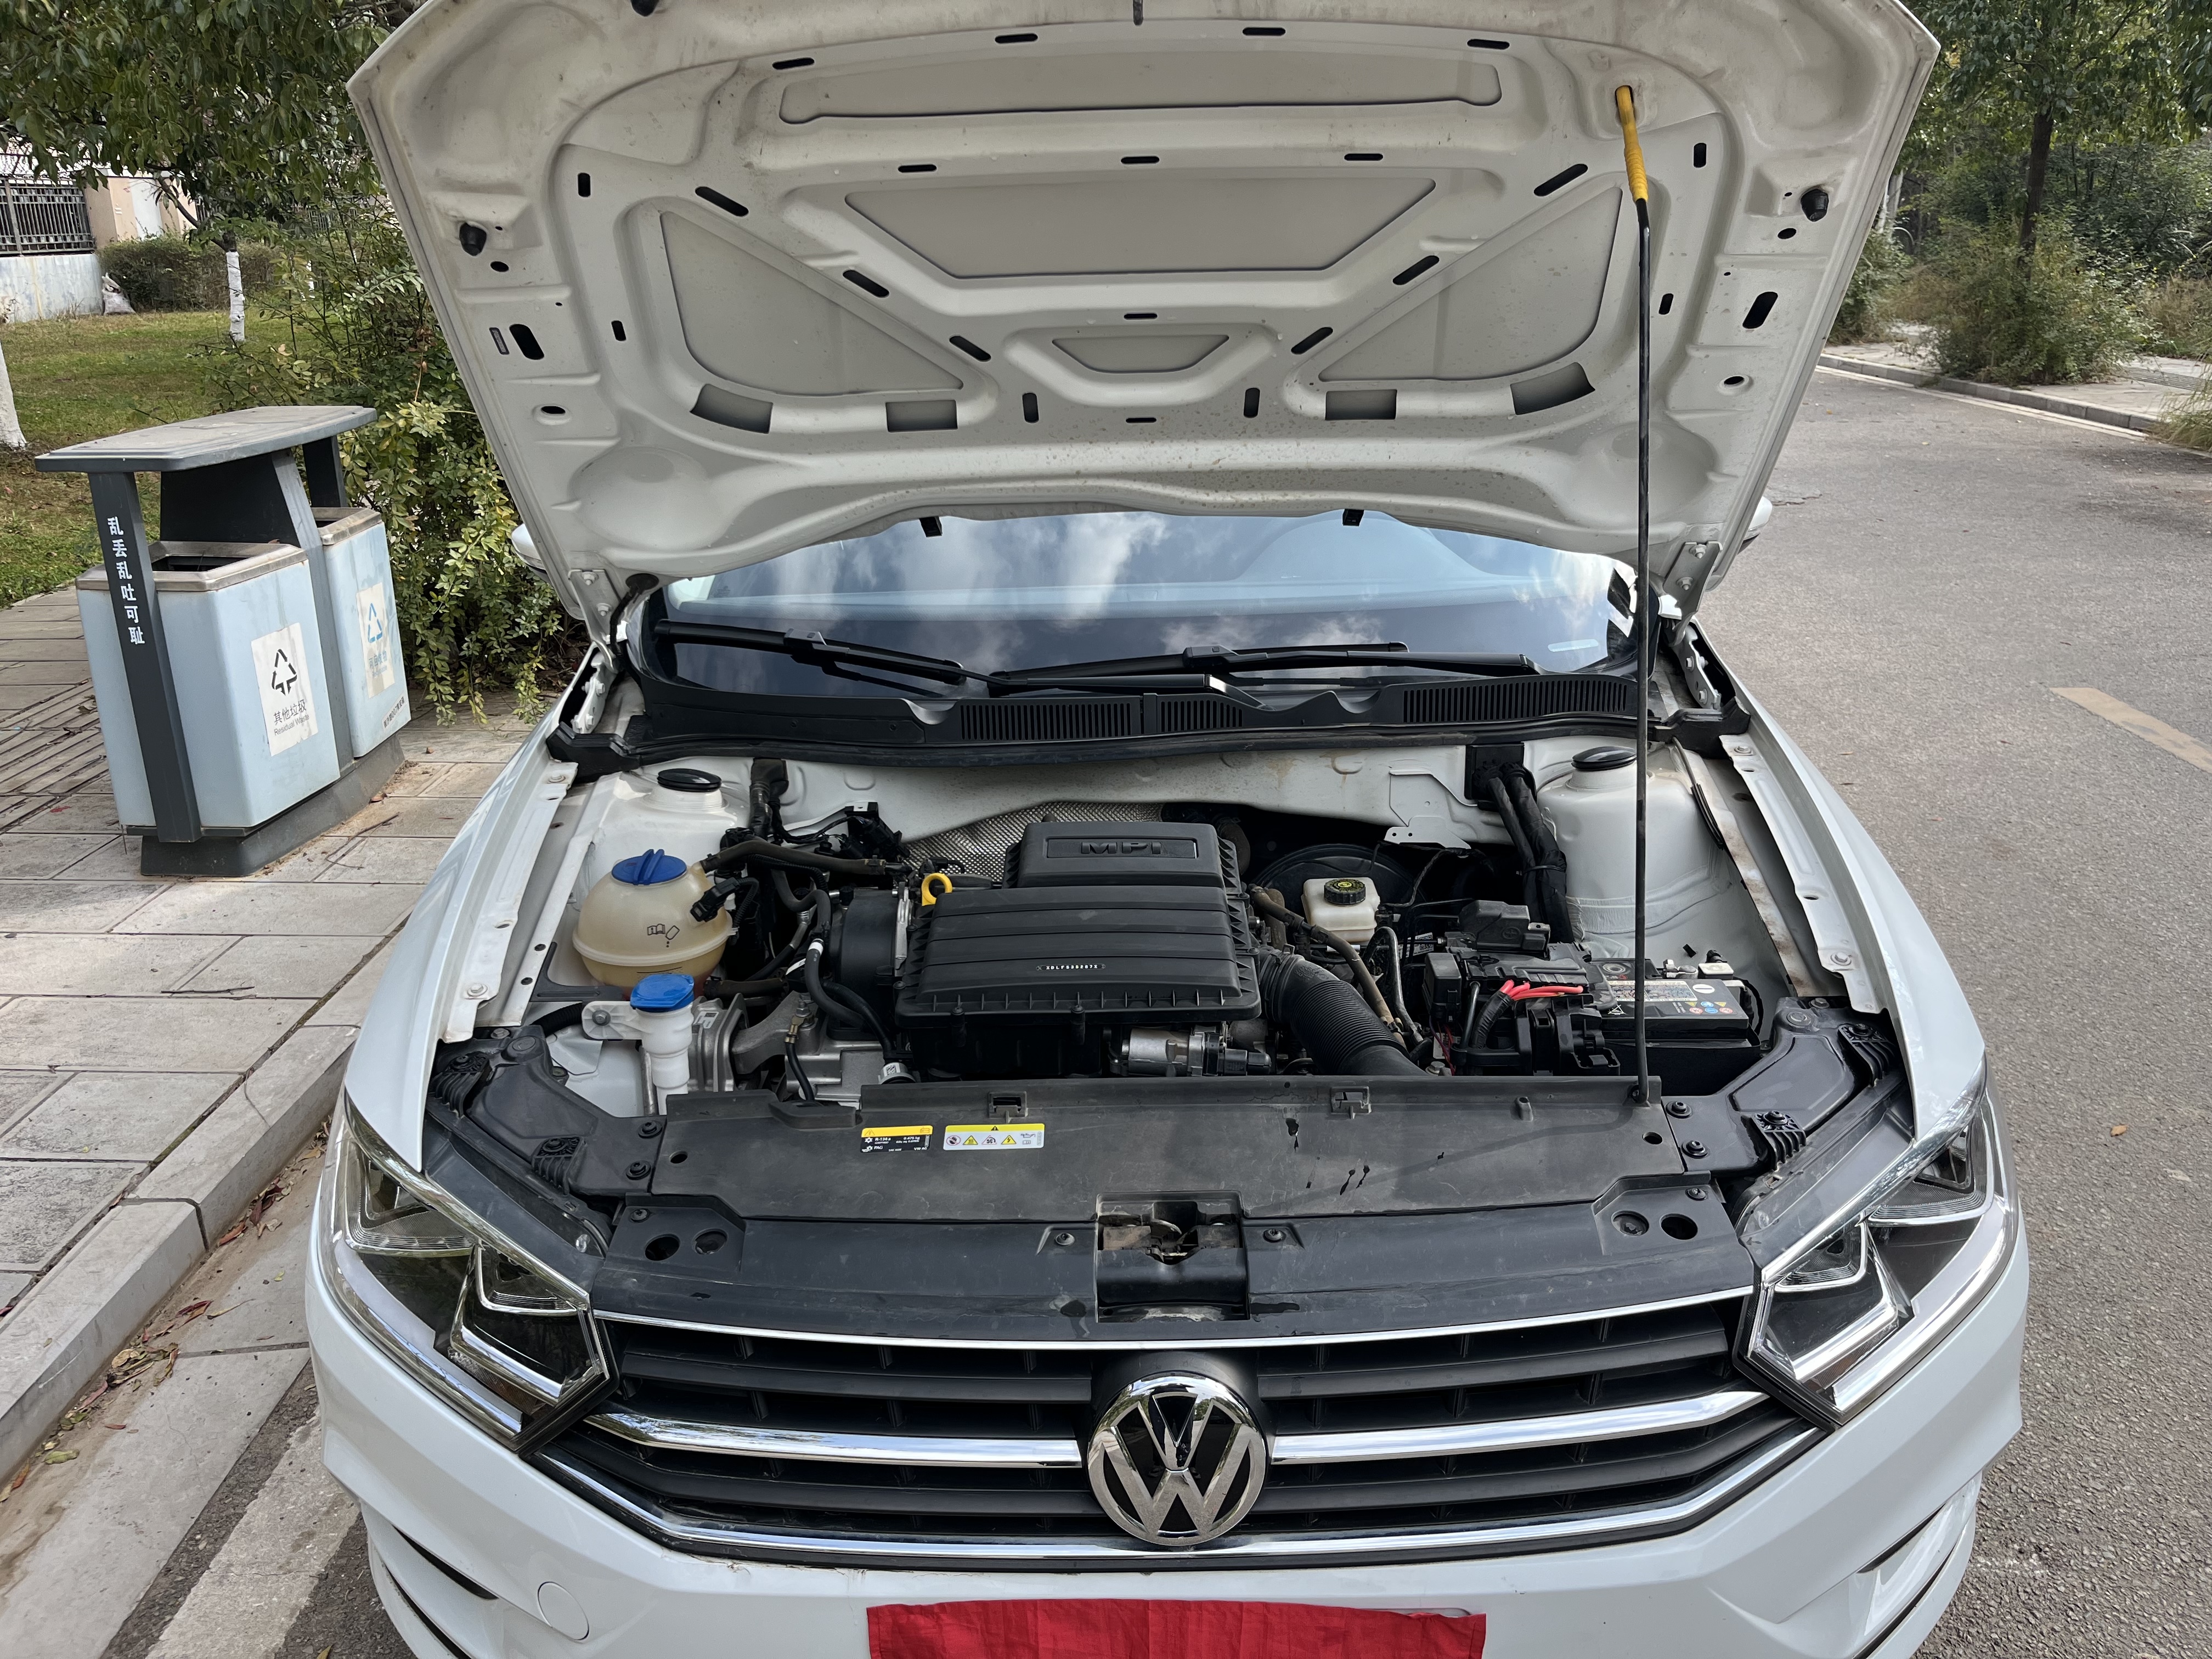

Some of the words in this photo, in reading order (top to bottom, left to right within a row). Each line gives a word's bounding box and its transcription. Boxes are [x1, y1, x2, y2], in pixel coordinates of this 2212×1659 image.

[108, 516, 145, 645] 乱丢乱吐可耻
[273, 699, 307, 725] 其他垃圾
[274, 720, 295, 736] Residual
[295, 714, 309, 725] Waste
[1080, 842, 1161, 855] MPI
[1097, 1379, 1259, 1542] VW
